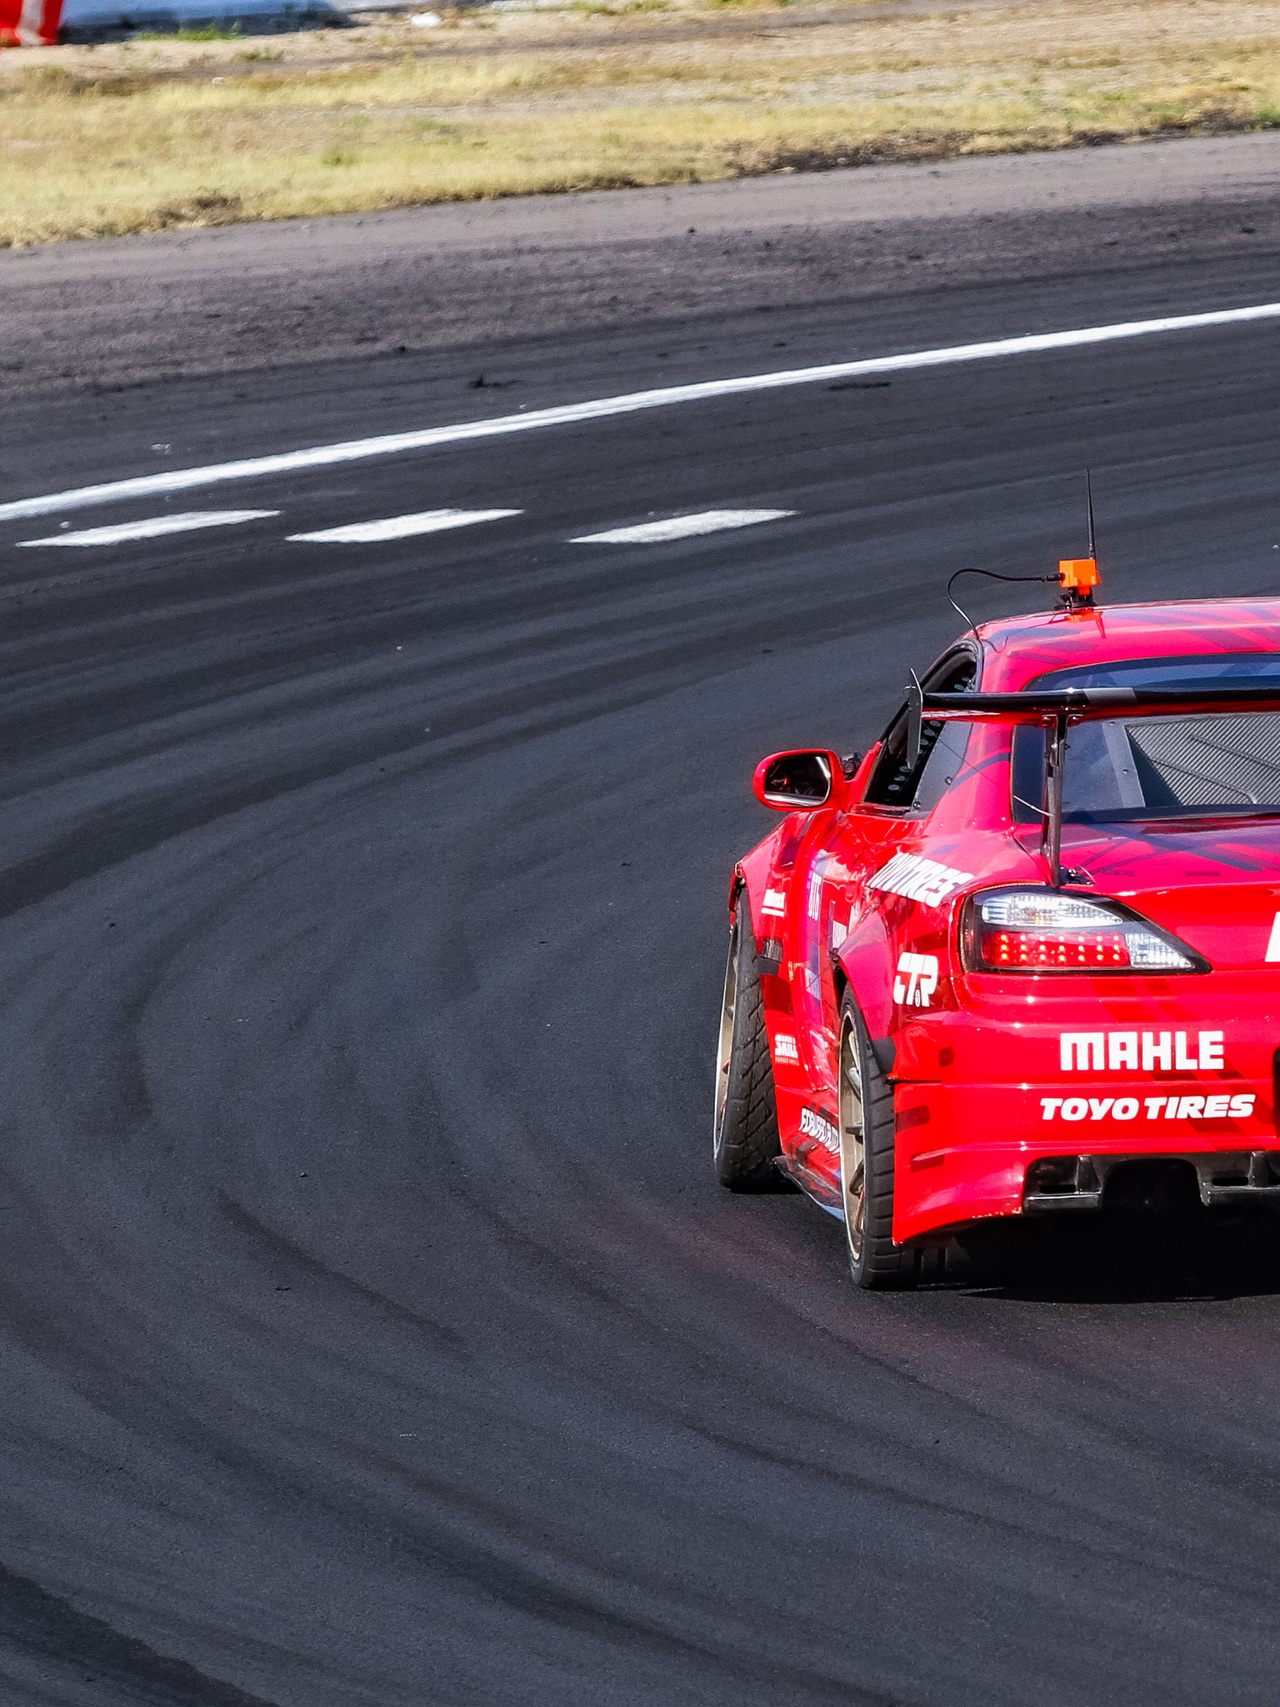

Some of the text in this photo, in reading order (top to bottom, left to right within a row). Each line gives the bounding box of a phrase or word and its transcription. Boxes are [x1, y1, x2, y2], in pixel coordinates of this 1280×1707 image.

[891, 859, 975, 908] TIRES
[1060, 1031, 1223, 1070] MAHLE
[1040, 1094, 1255, 1120] TOYO TIRES
